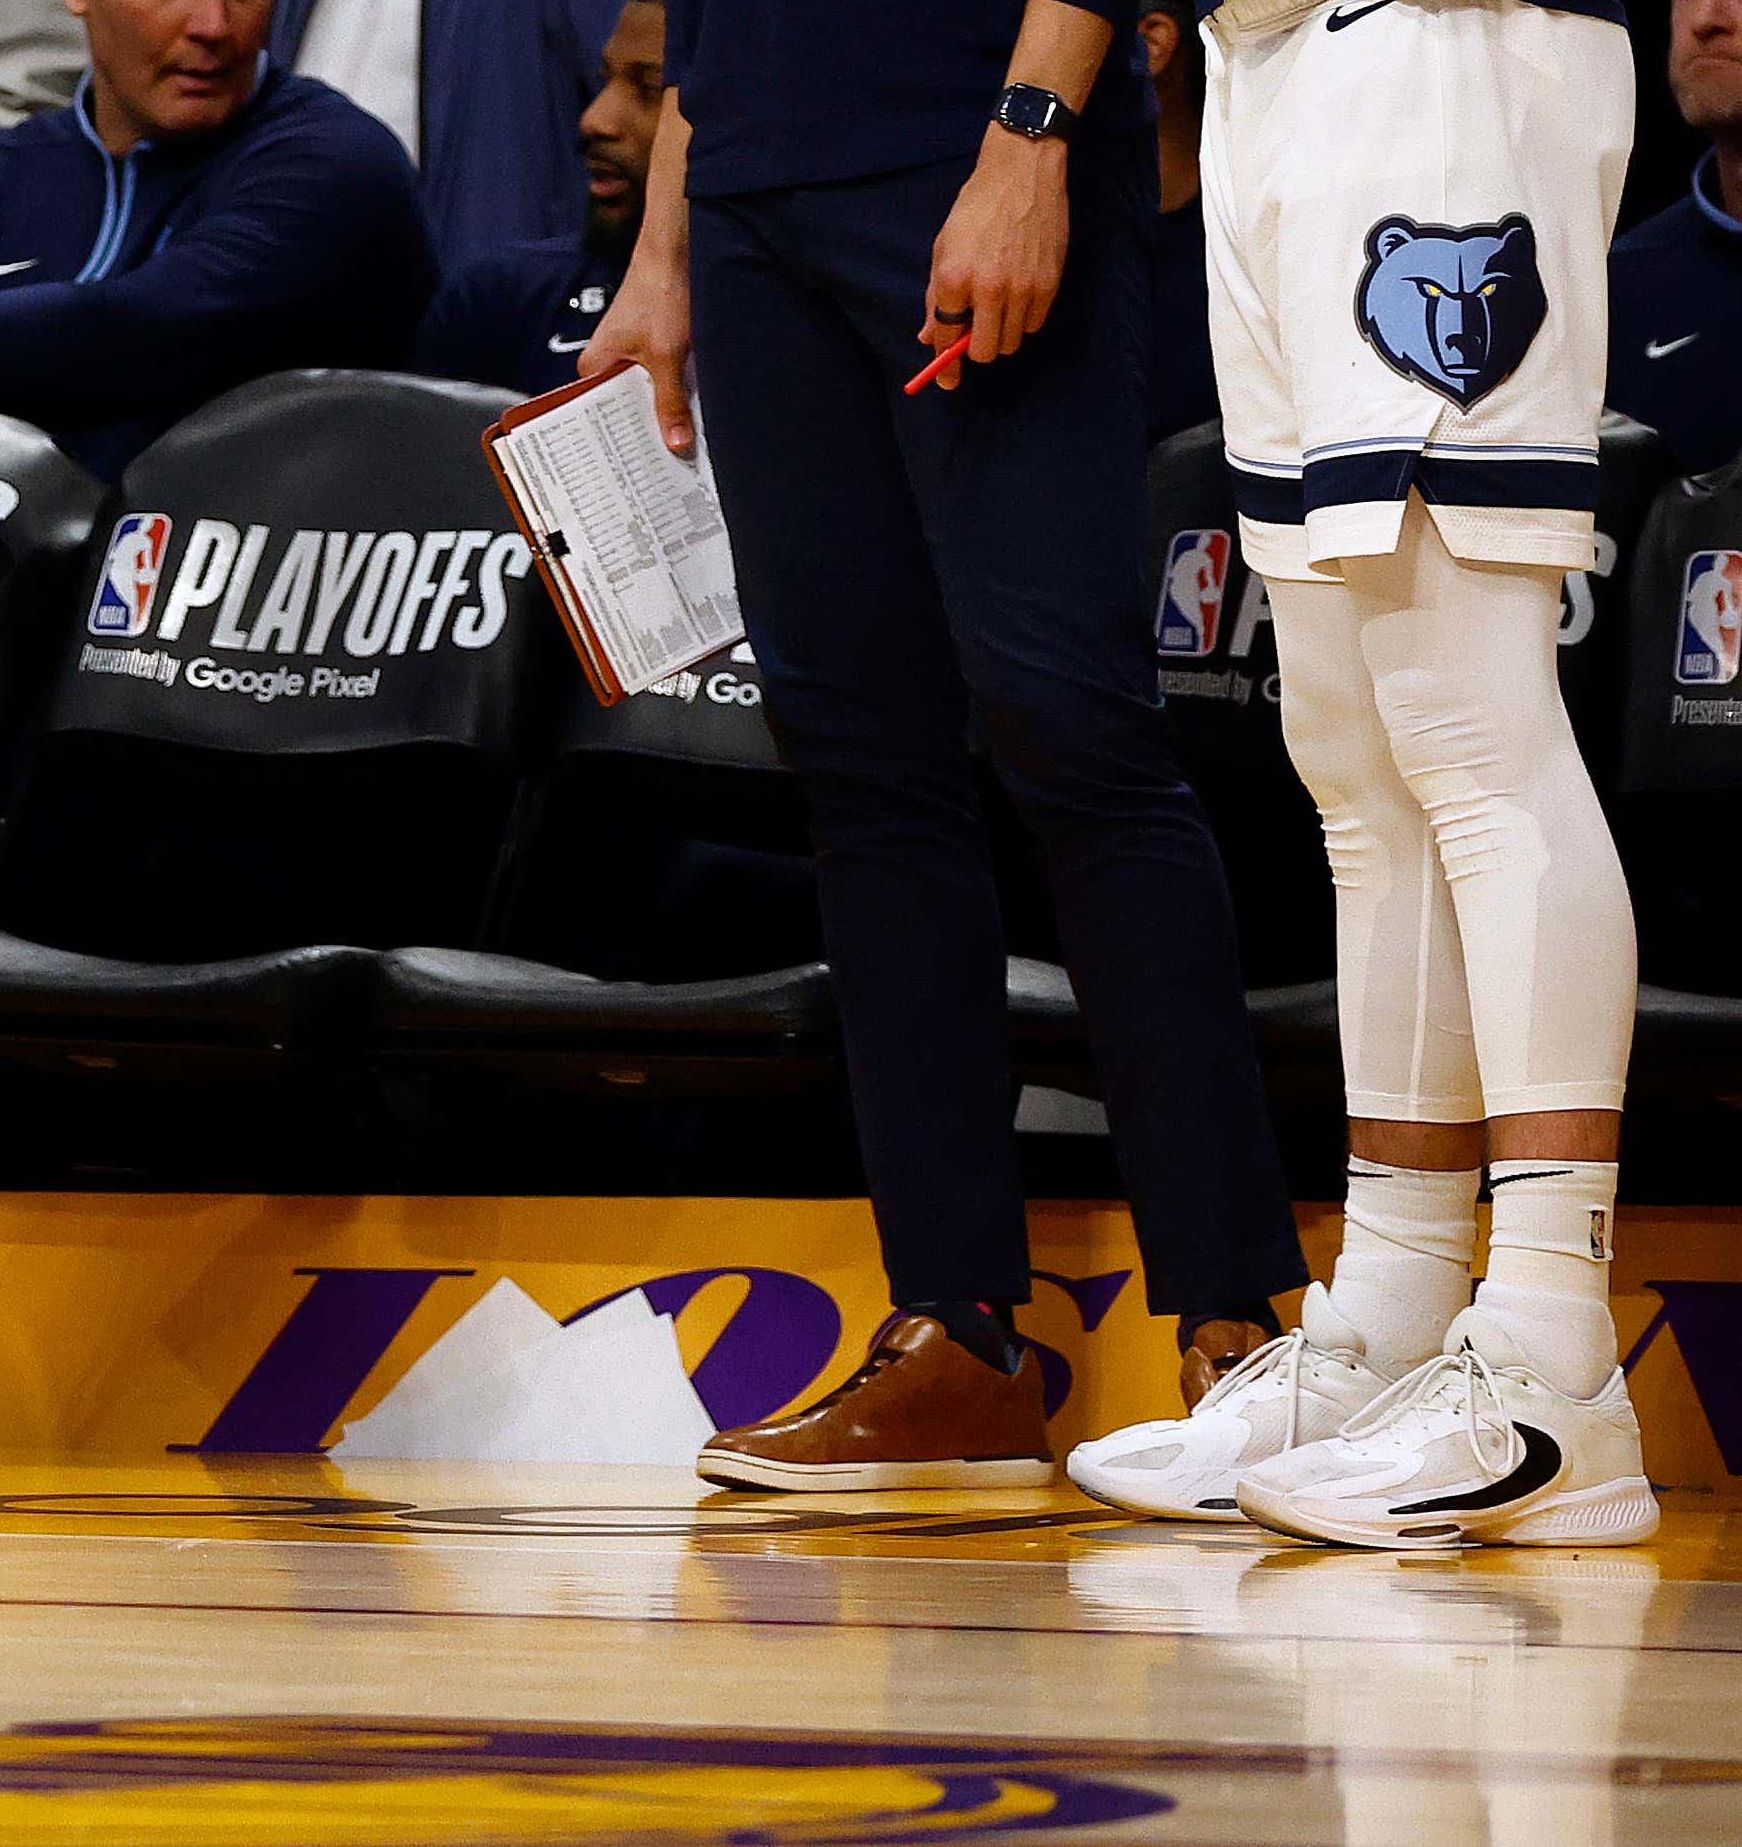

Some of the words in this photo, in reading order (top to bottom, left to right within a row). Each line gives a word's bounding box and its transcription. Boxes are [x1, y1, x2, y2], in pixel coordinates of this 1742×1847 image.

[156, 517, 534, 658] PLAYOFFS
[183, 656, 306, 704] Google
[307, 665, 382, 699] Pixel
